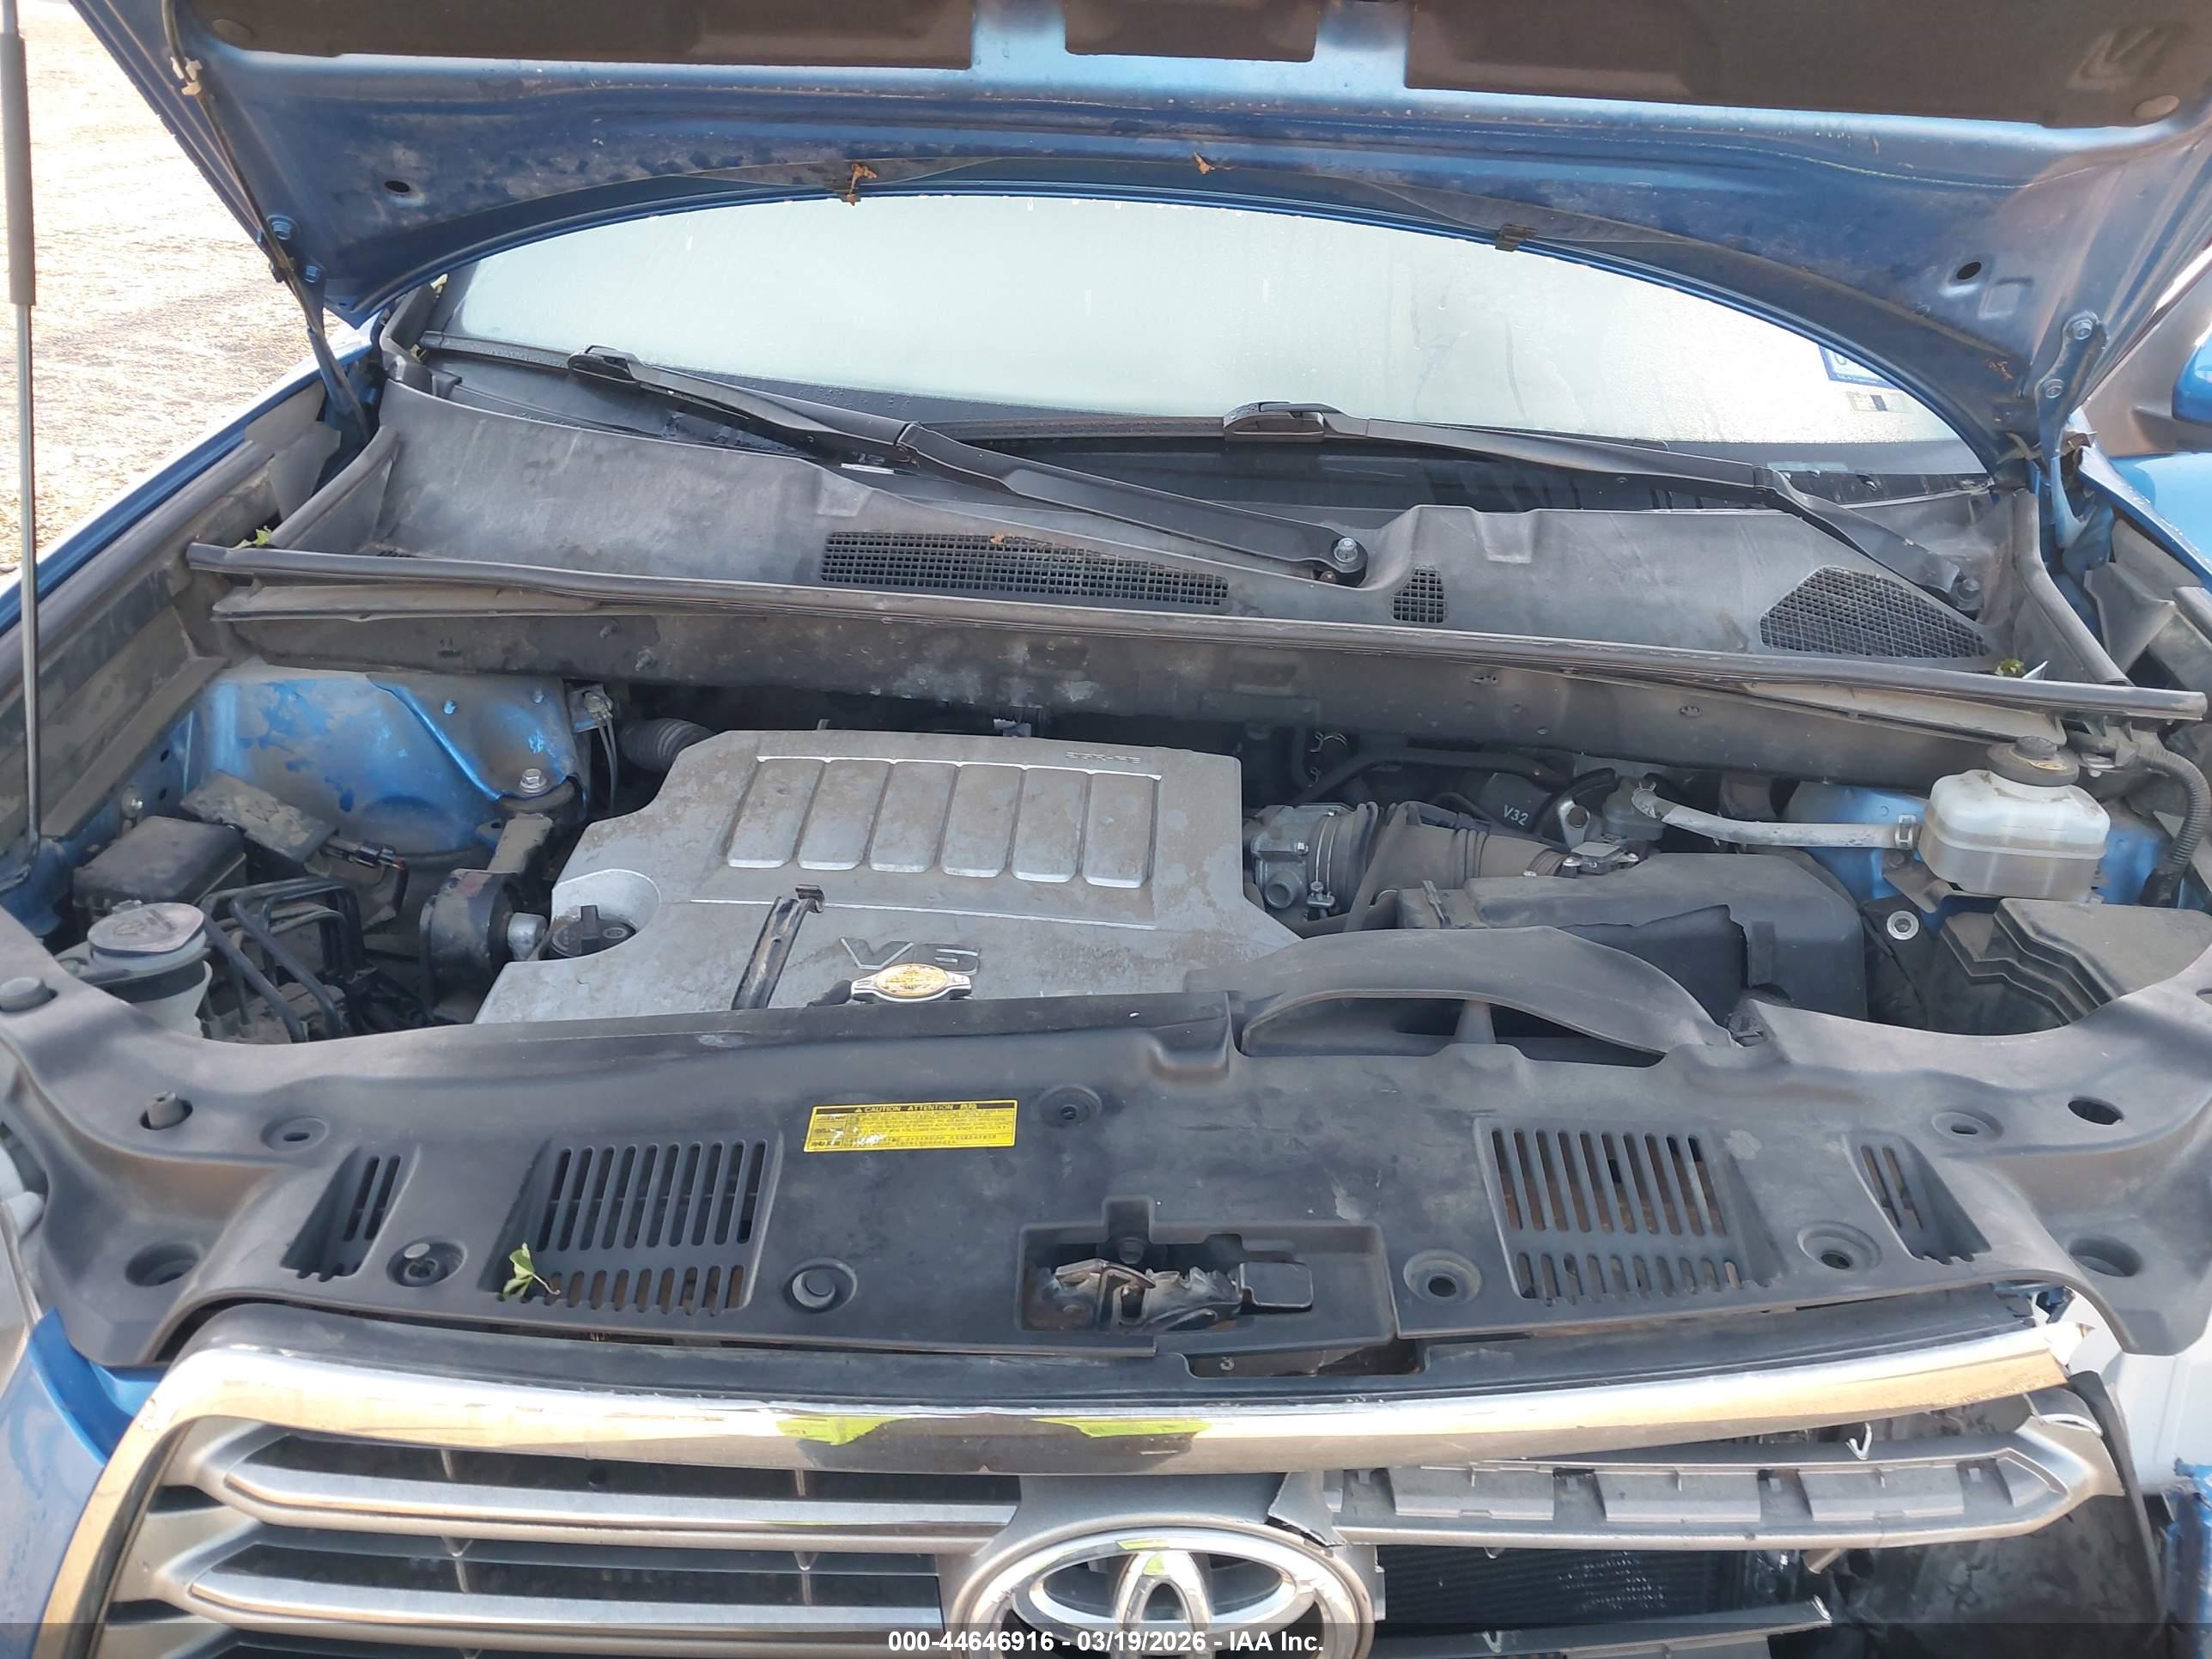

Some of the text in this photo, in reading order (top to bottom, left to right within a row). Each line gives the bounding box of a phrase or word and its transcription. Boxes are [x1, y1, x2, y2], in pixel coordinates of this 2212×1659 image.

[1503, 804, 1528, 826] V32
[839, 936, 981, 976] V6
[907, 1103, 953, 1112] ATTENTION
